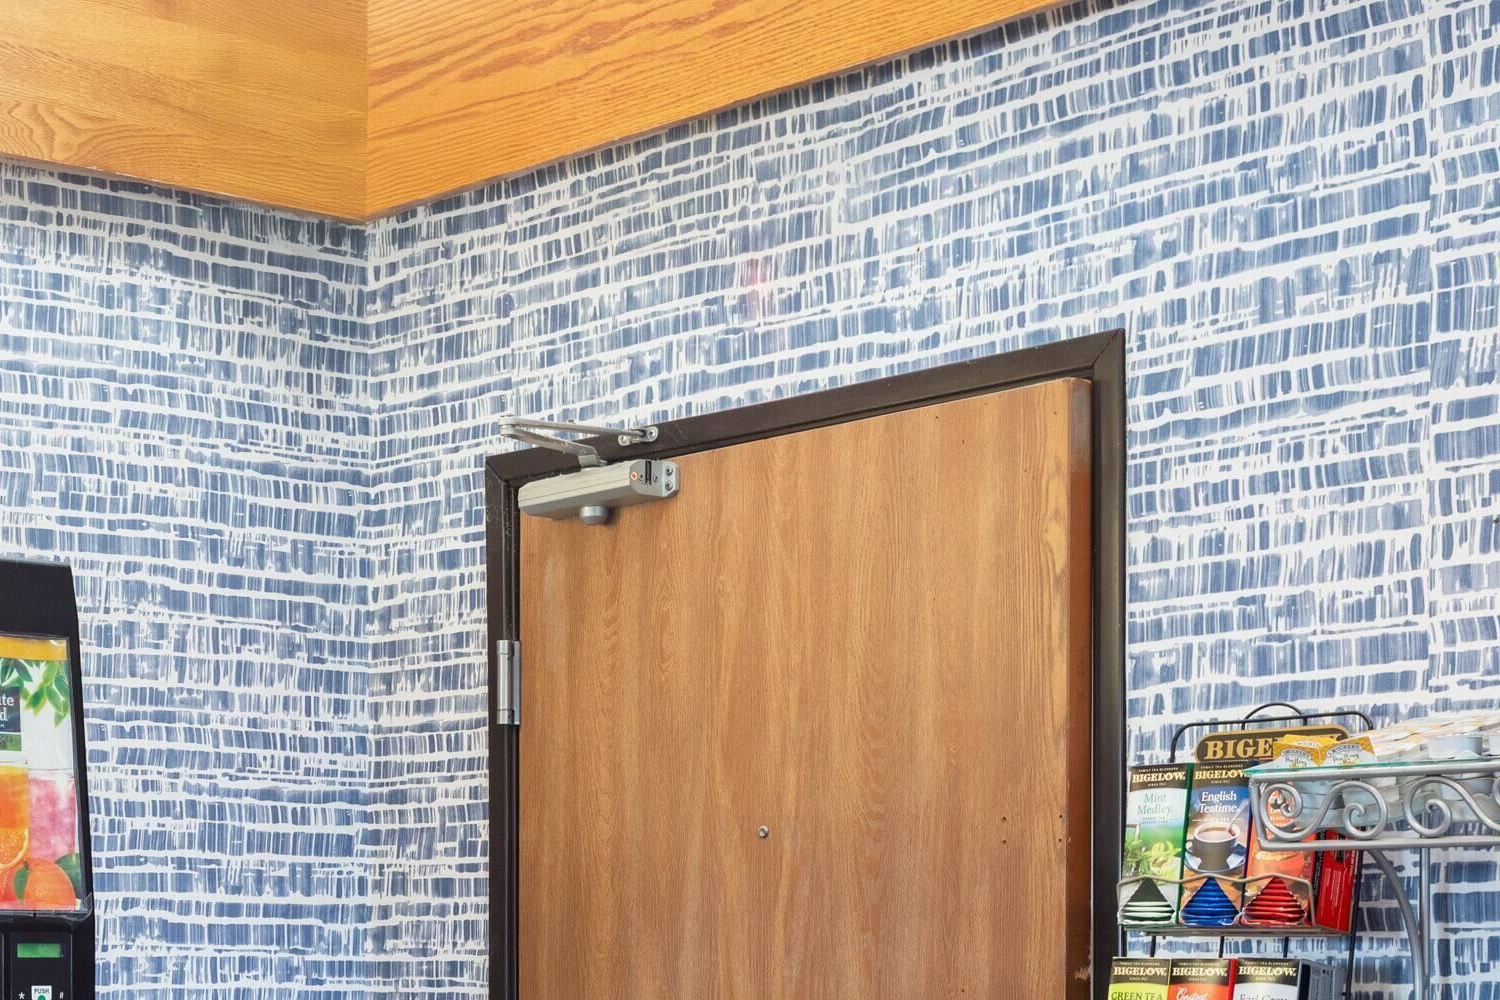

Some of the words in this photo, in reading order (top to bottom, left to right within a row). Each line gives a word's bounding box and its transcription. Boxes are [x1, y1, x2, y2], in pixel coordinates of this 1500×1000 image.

[1204, 736, 1273, 759] BIGE
[1144, 793, 1166, 803] Mint
[1202, 790, 1237, 804] English
[1111, 992, 1142, 1000] GREEN
